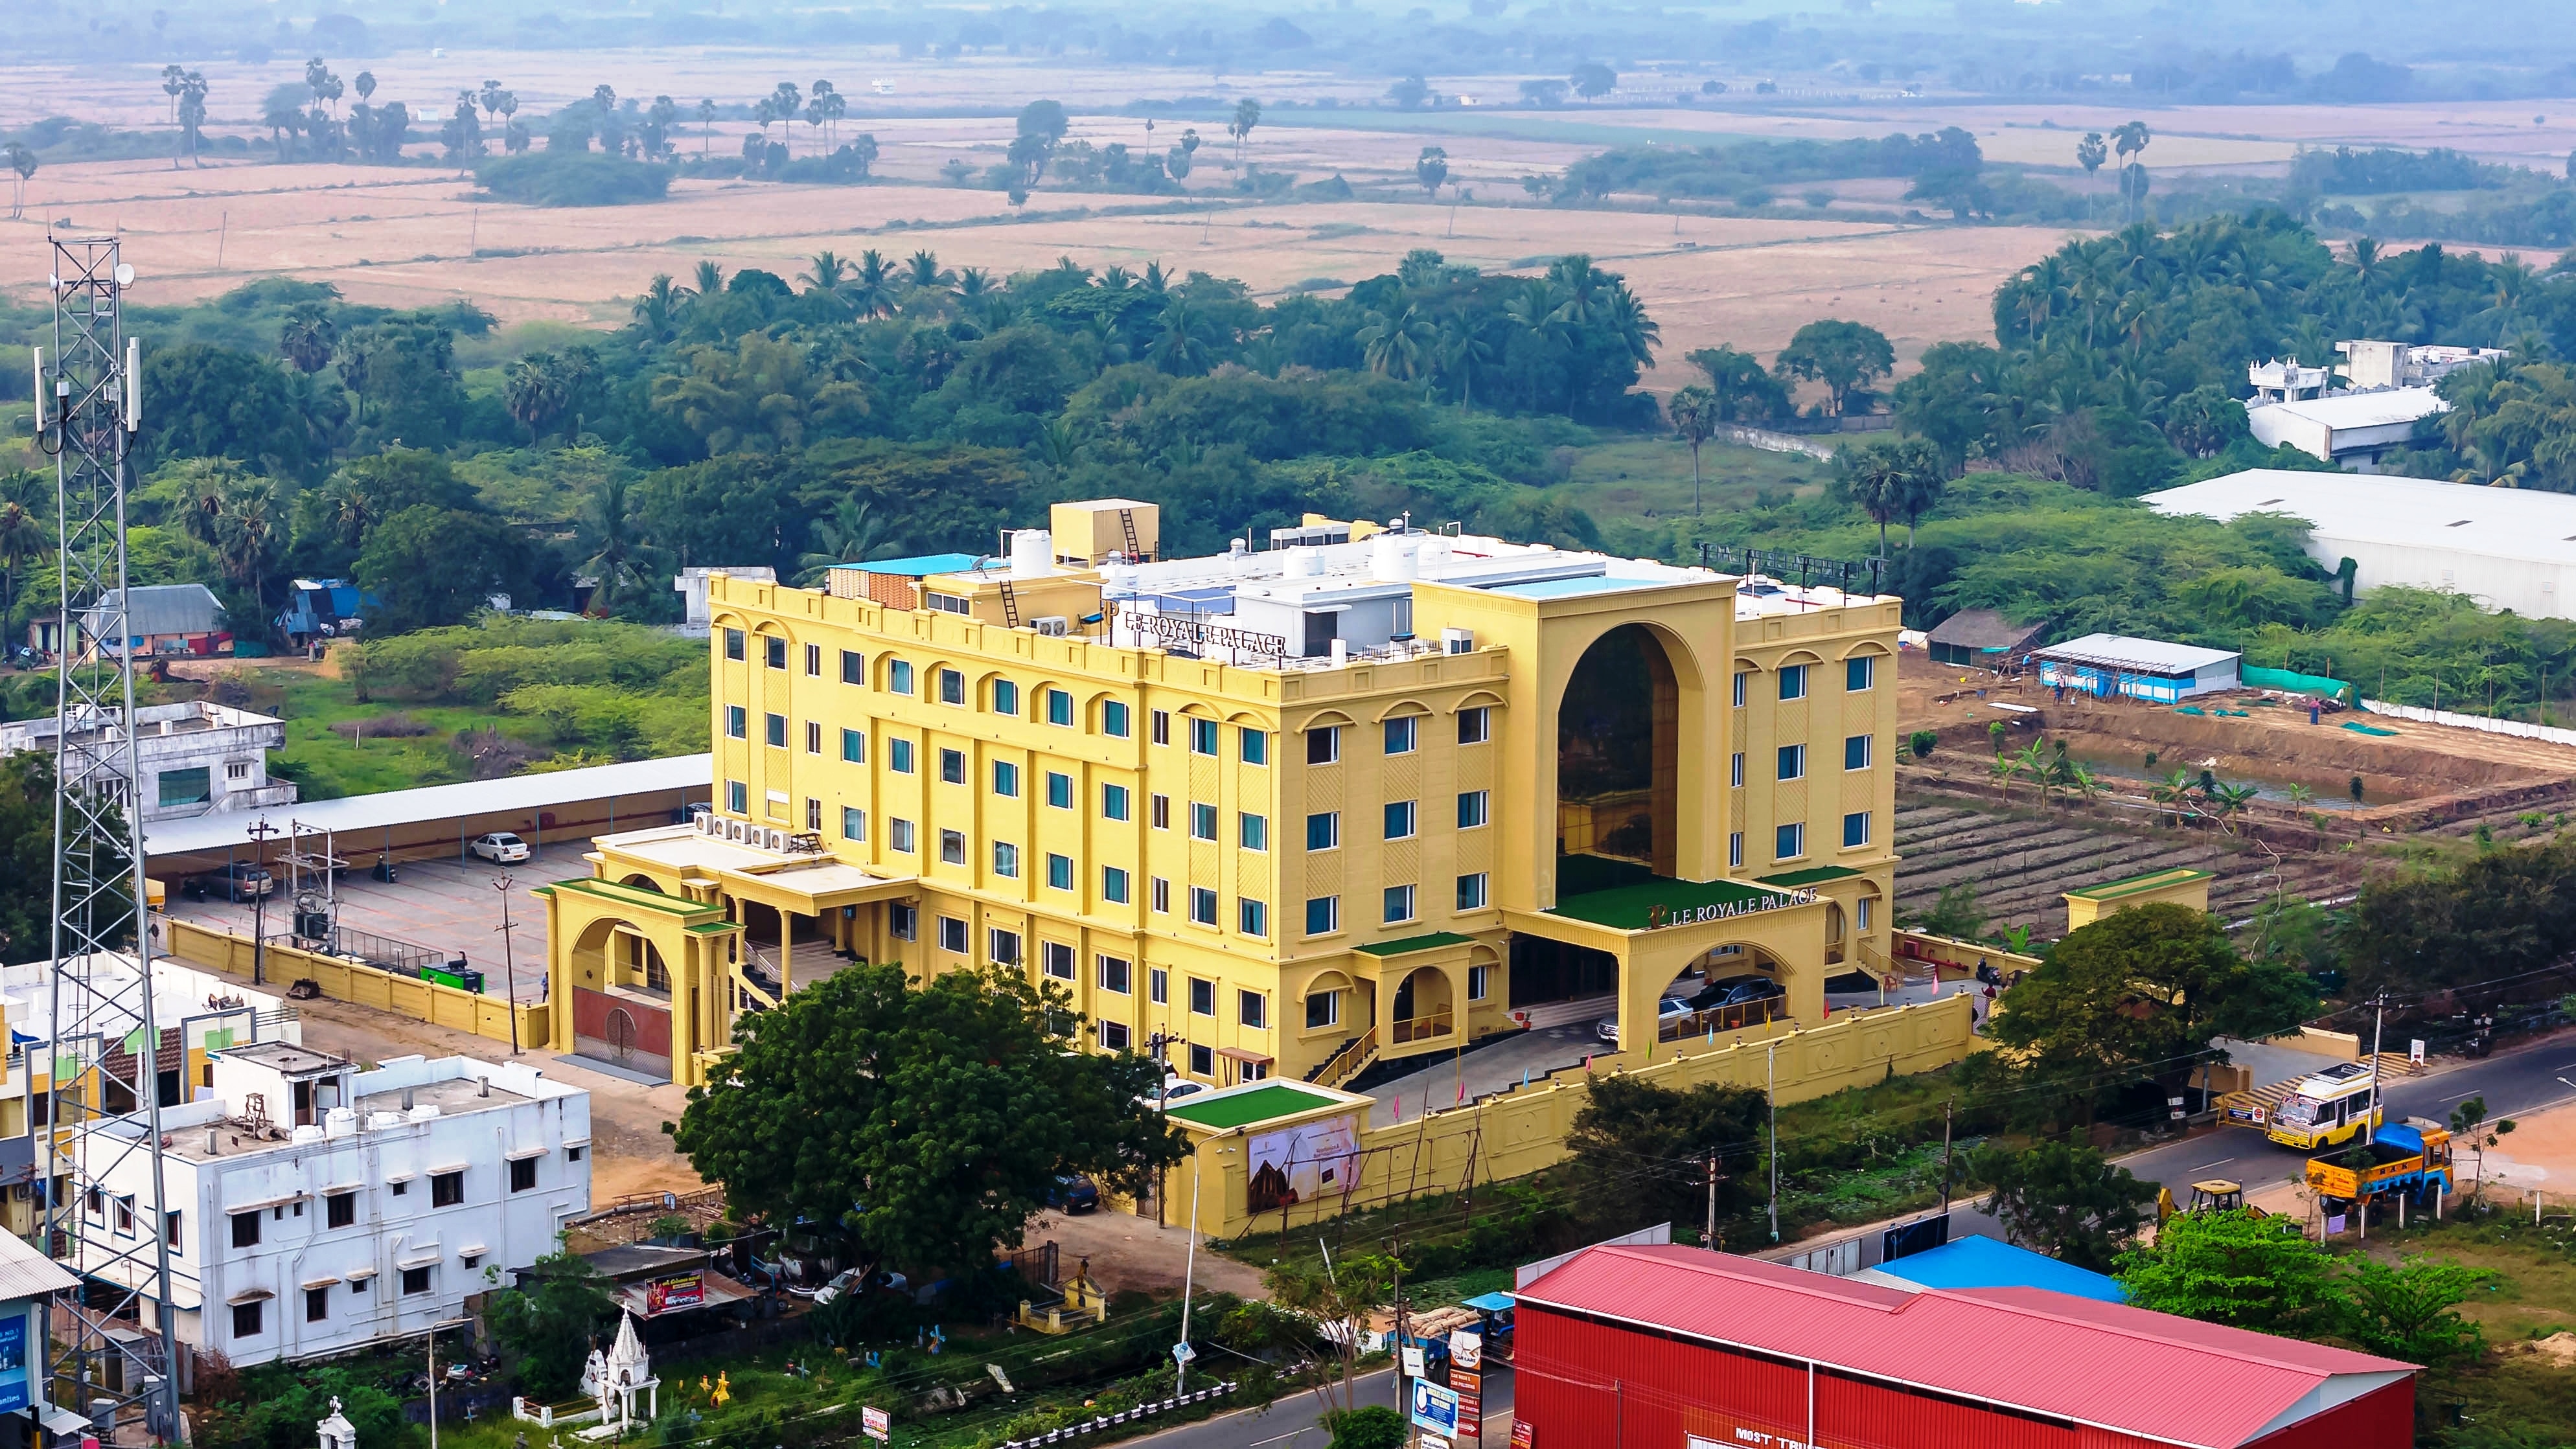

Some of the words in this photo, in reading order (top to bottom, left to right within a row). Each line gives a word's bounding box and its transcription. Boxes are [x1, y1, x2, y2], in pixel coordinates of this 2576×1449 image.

[1124, 612, 1144, 632] LE
[1147, 616, 1215, 645] ROYALE
[1218, 628, 1287, 657] PALACE
[1672, 909, 1692, 926] LE
[1696, 898, 1757, 922] ROYALE
[1761, 887, 1818, 911] PALACE
[1736, 1427, 1773, 1445] MOST
